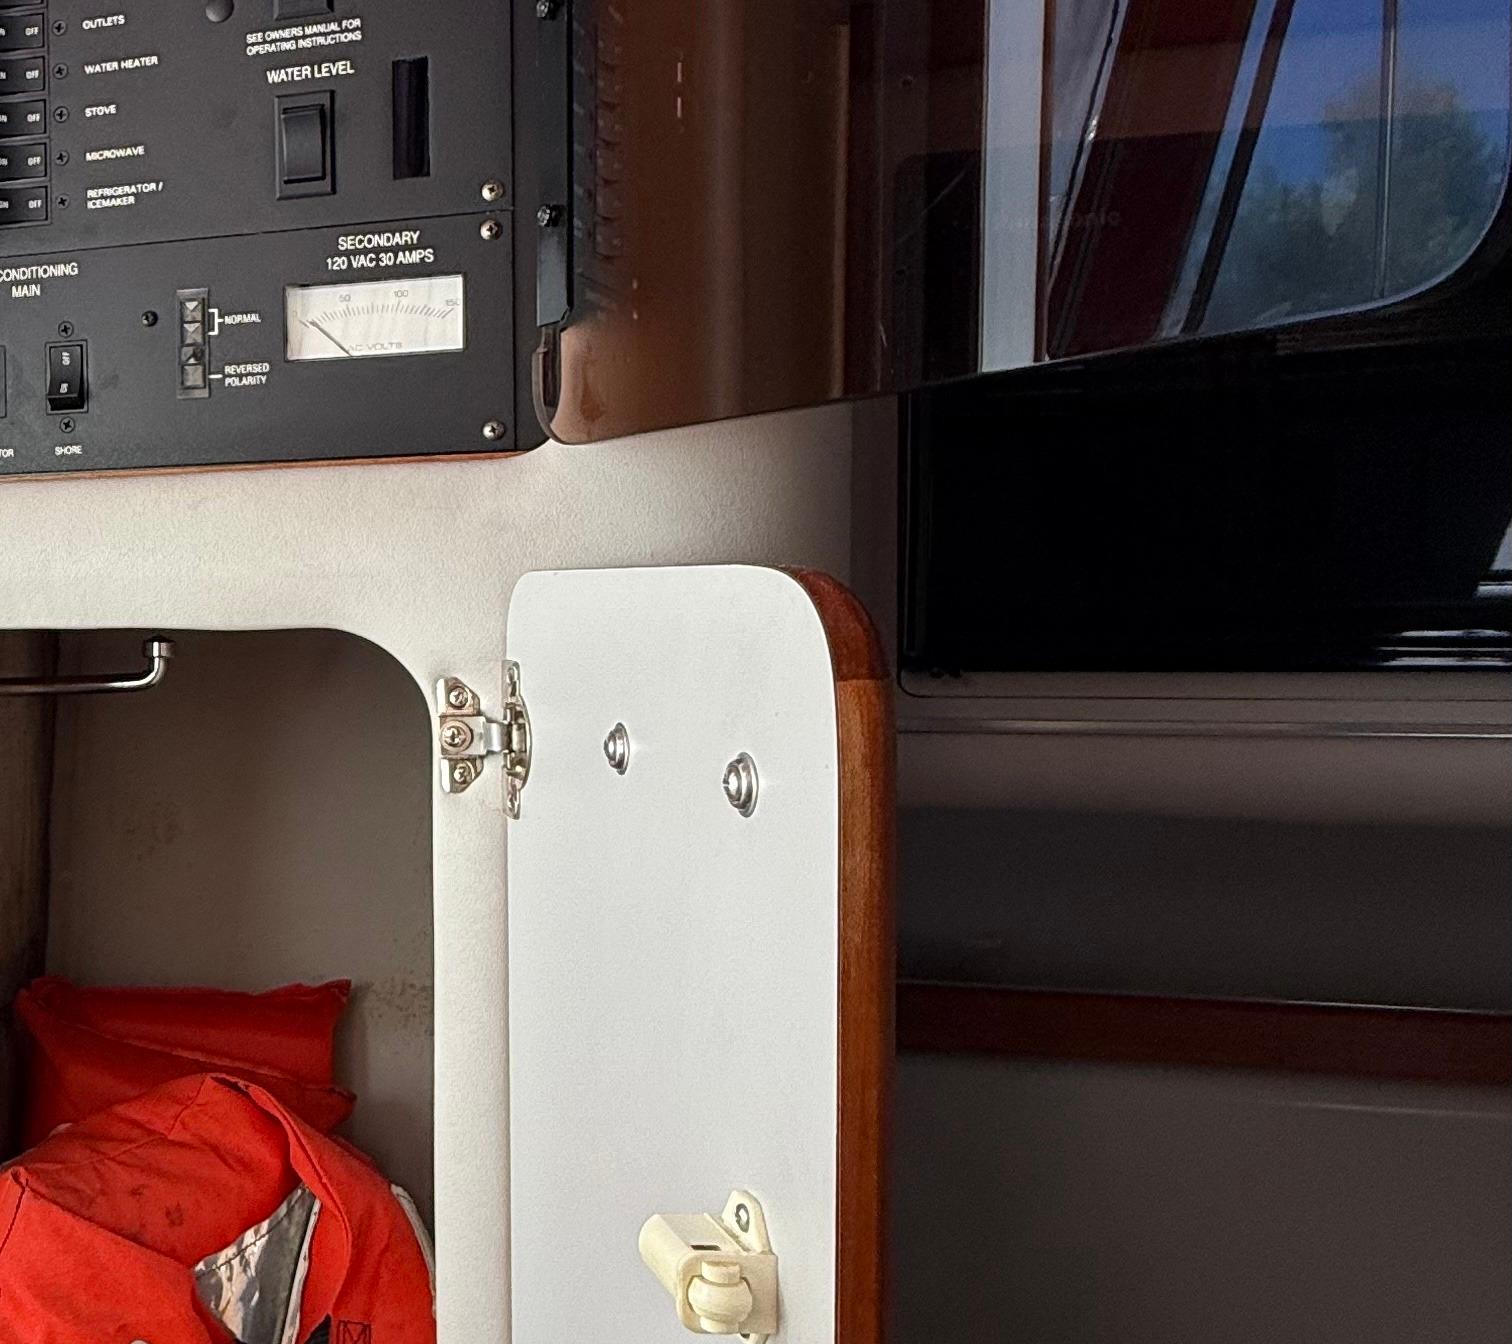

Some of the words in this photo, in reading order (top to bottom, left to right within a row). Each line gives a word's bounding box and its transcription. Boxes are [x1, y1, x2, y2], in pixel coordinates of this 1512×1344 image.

[82, 14, 126, 30] OUTLETS
[246, 32, 263, 44] SEE
[264, 27, 304, 41] OWNERS
[304, 22, 340, 36] MANUAL
[342, 18, 361, 30] FOR
[246, 40, 296, 56] OPERATING
[298, 31, 362, 49] INSTRUCTIONS
[84, 59, 119, 75] WATER
[120, 55, 159, 71] HEATER
[266, 66, 311, 85] WATER
[314, 61, 355, 78] LEVEL
[27, 113, 40, 123] OFF
[85, 104, 117, 118] STOVE
[85, 146, 145, 162] MICROWAVE
[87, 196, 135, 210] ICEMAKER
[338, 230, 420, 251] SECONDARY
[326, 256, 347, 271] 120
[350, 254, 376, 269] VAC
[378, 252, 395, 266] 30
[396, 249, 434, 265] AMPS
[11, 284, 41, 298] MAIN
[224, 313, 261, 325] NORMAL
[224, 363, 270, 377] REVERSED
[224, 374, 267, 387] POLARITY
[55, 445, 83, 456] SHORE
